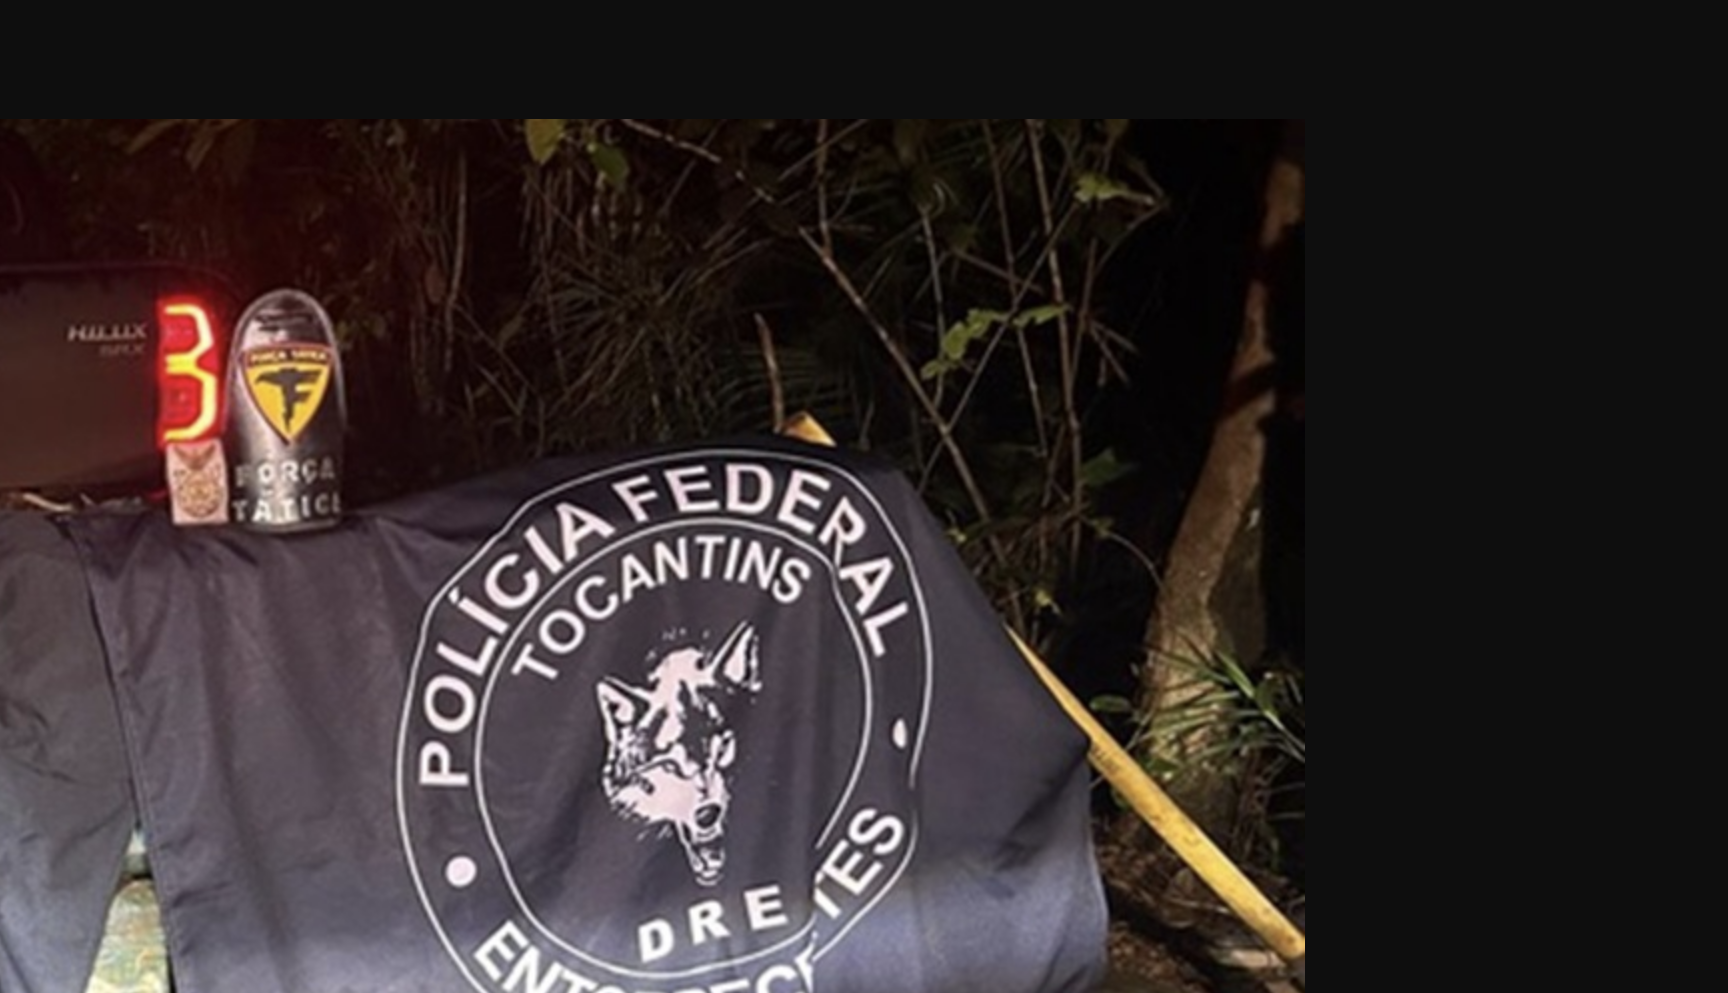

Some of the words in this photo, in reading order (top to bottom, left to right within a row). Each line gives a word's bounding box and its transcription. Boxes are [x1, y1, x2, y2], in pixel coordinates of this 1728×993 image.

[419, 501, 616, 788] POLÍCIA
[612, 462, 909, 657] FEDERAL
[511, 535, 812, 683] TOCANTINS
